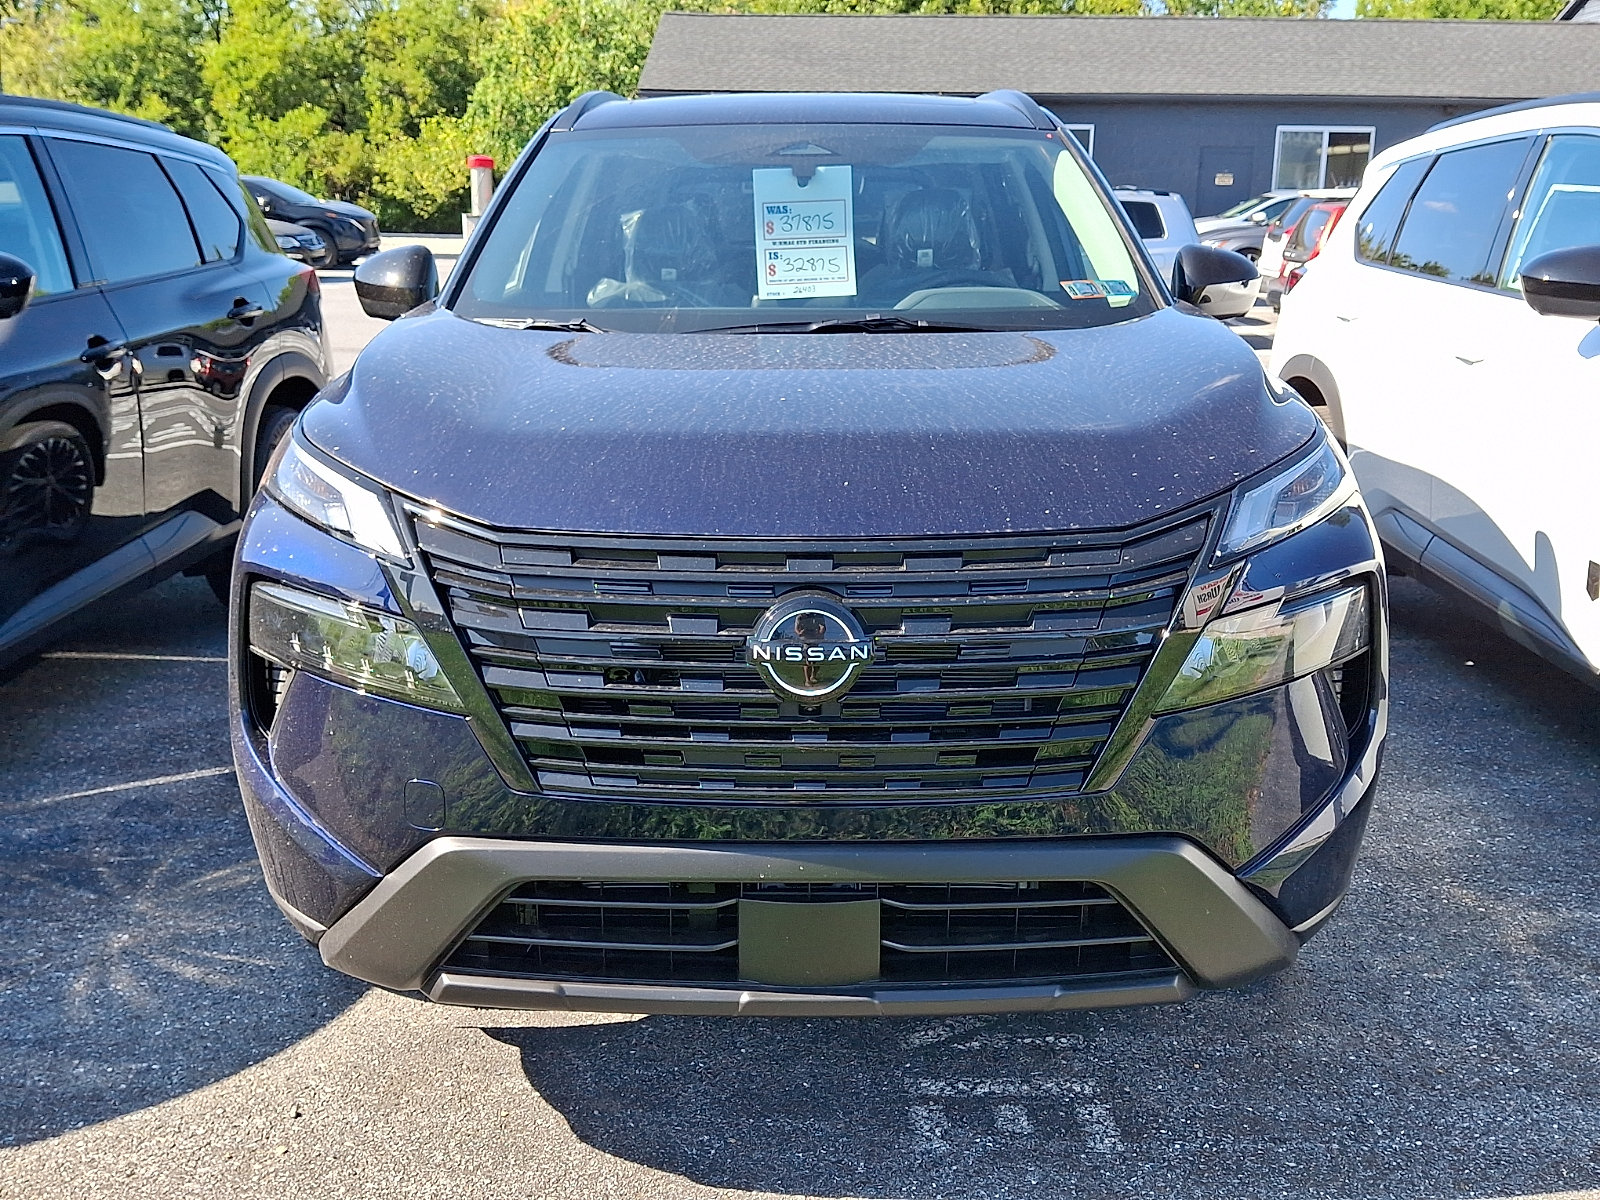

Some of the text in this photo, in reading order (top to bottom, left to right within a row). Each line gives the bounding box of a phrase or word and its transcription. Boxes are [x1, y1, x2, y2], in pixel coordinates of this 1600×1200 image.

[766, 206, 792, 214] WAS:
[766, 212, 834, 235] $ 37875
[768, 251, 783, 260] IS:
[768, 257, 841, 277] $ 32875
[752, 644, 868, 662] NISSAN
